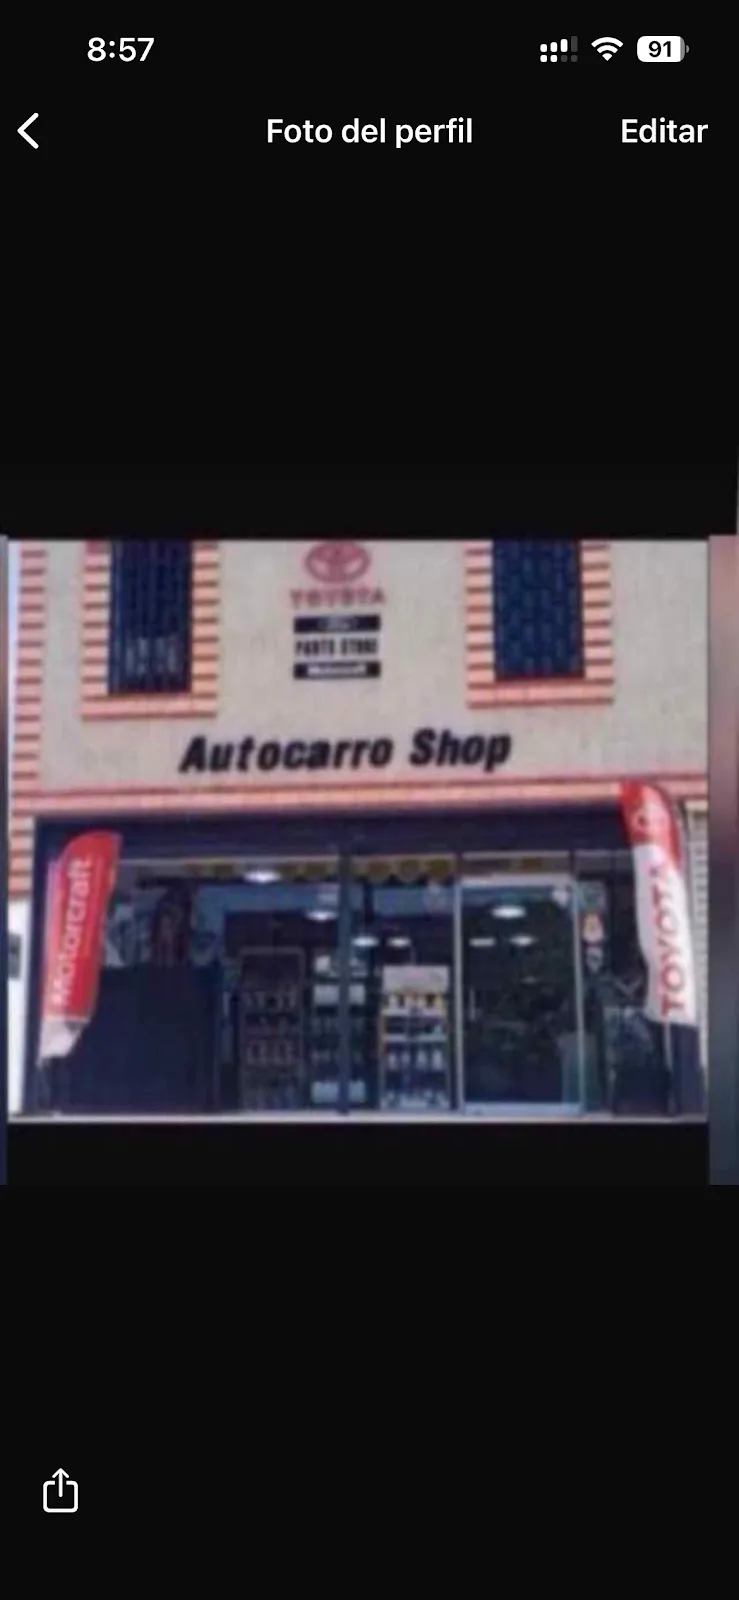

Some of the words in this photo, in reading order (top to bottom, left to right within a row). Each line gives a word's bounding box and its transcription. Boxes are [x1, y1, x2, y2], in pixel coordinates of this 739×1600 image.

[87, 36, 154, 62] 8:57
[648, 41, 672, 58] 91
[267, 119, 333, 144] Foto
[342, 118, 386, 144] del
[396, 117, 473, 148] perfil
[621, 117, 708, 144] Editar
[290, 586, 386, 608] TOYOTA
[179, 735, 395, 773] Autocarro
[408, 727, 512, 773] Shop
